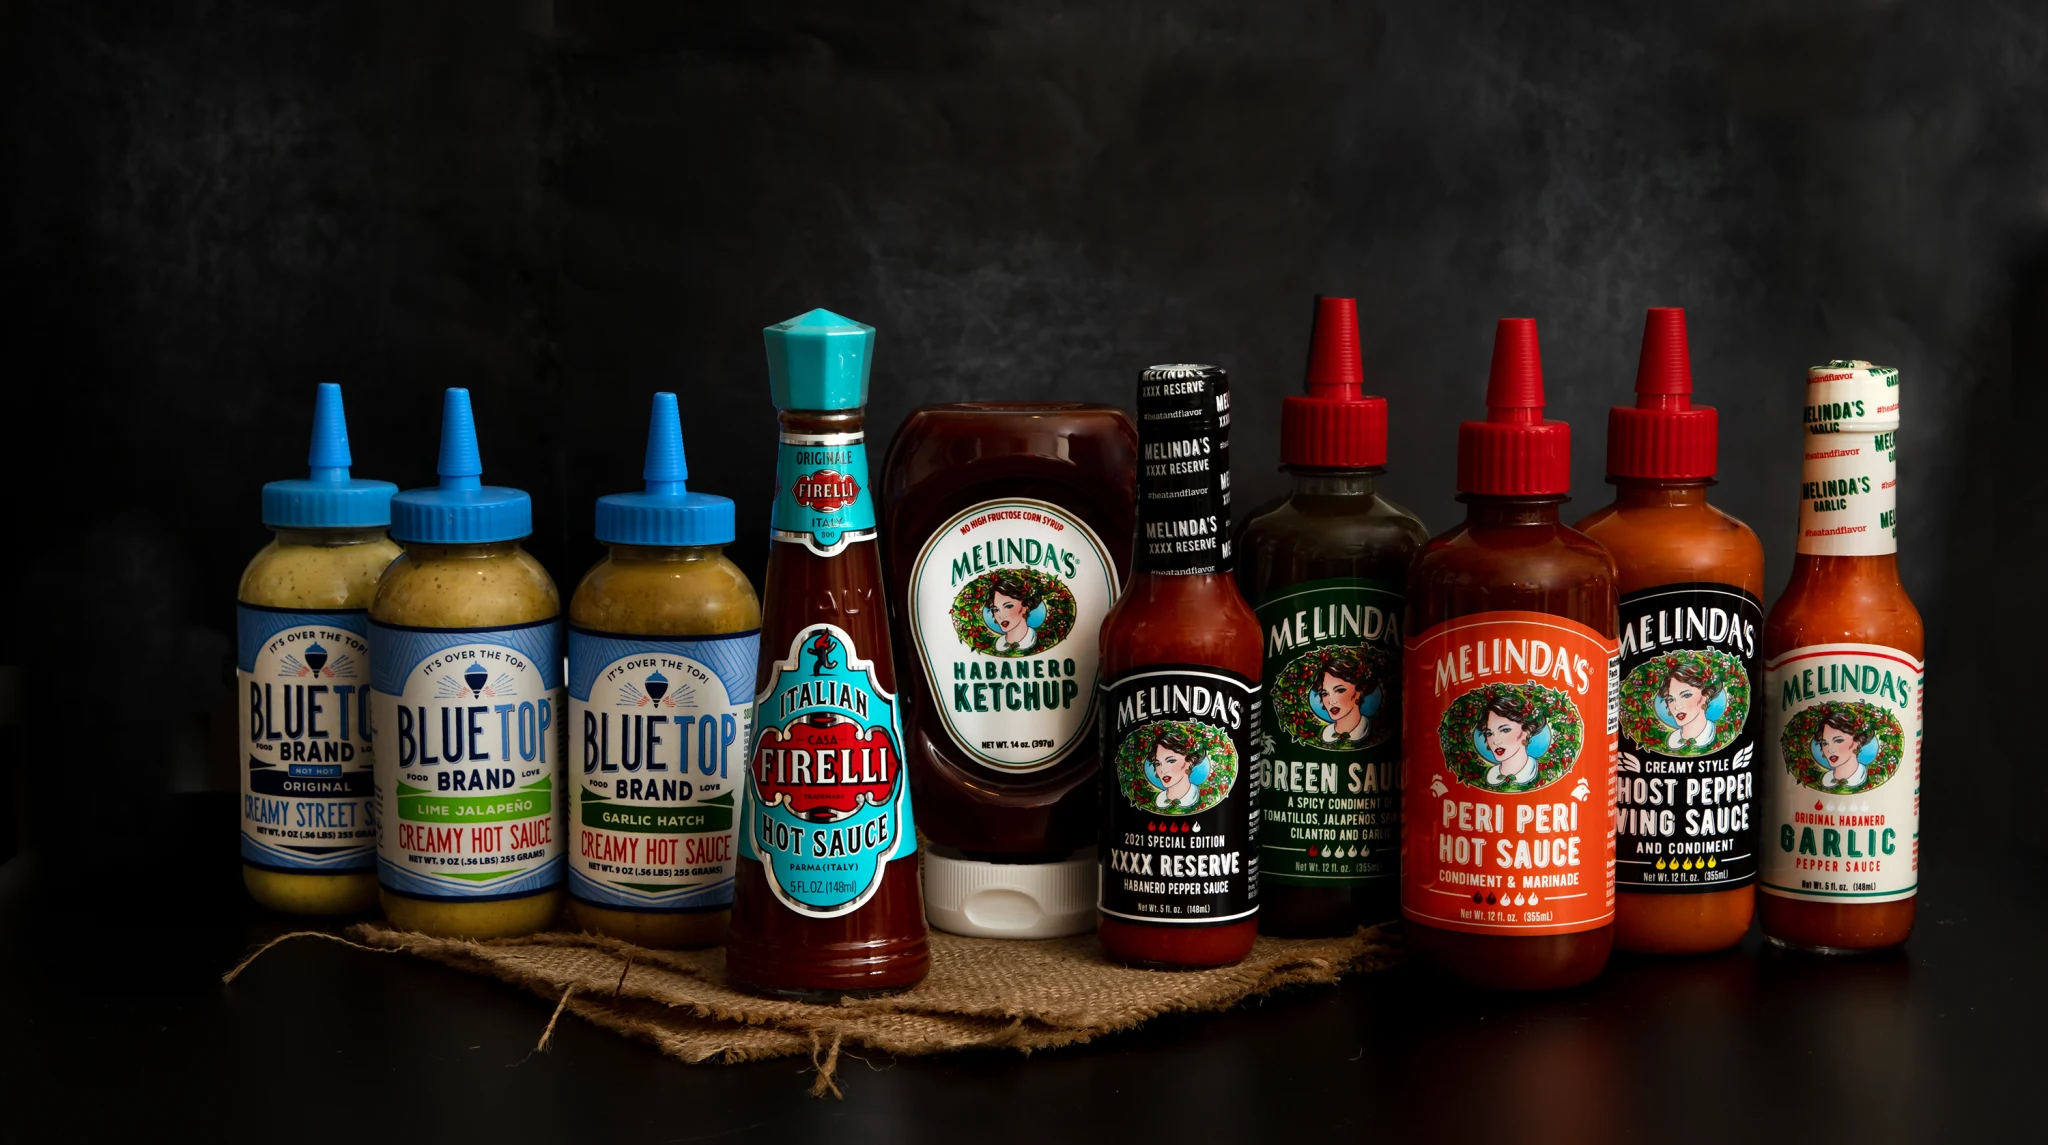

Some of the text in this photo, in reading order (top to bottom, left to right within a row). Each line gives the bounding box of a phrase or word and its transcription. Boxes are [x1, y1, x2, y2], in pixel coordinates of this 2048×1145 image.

[1143, 380, 1205, 397] XXXX RESERVE
[1810, 422, 1840, 435] GARLIC
[1145, 436, 1211, 460] MELINDA'S
[796, 451, 853, 465] ORIGINALE
[1146, 459, 1210, 476] XXXX RESERVE
[799, 483, 853, 498] FIRELLI
[1148, 488, 1208, 499] #heatandflavor
[1803, 476, 1871, 500] MELINDA'S
[1814, 498, 1847, 512] GARLIC
[812, 518, 843, 528] ITALY
[960, 511, 1064, 535] NO HIGH FRUCTOSE CORN SYRUP
[1146, 516, 1218, 539] MELINDA'S
[1805, 526, 1867, 537] #heatandflavor
[1149, 542, 1173, 555] XXXX
[1176, 537, 1217, 553] RESERVE
[951, 538, 1077, 588] MELINDA'S
[269, 631, 369, 655] IT'S OVER THE TOP!
[424, 650, 527, 676] IT'S OVER THE TOP!
[607, 659, 709, 684] IT'S OVER THE TOP!
[954, 658, 1076, 681] HABANERO
[1434, 638, 1589, 697] MELINDA'S
[954, 680, 1079, 712] KETCHUP
[1782, 664, 1909, 711] MELINDA'S
[780, 680, 869, 721] ITALIAN
[1117, 684, 1241, 732] MELINDA'S
[808, 735, 838, 745] CASA
[1010, 741, 1019, 749] 14
[1032, 740, 1054, 749] (397g)
[256, 743, 273, 751] FOOD
[280, 741, 355, 762] BRAND
[760, 747, 889, 787] FIRELLI
[1646, 759, 1729, 774] CREAMY STYLE
[407, 768, 540, 791] FOOD BRAND LOVE
[1260, 758, 1338, 794] GREEN
[283, 781, 352, 792] ORIGINAL
[590, 780, 608, 788] FOOD
[616, 779, 693, 801] BRAND
[1686, 772, 1752, 806] PEPPER
[244, 794, 290, 826] CREAMY
[296, 802, 358, 828] STREET
[418, 799, 533, 816] LIME JALAPEÑO
[1288, 796, 1380, 810] A SPICY CONDIMENT
[602, 812, 704, 826] GARLIC HATCH
[1264, 809, 1320, 826] TOMATILLOS,
[1443, 799, 1578, 833] PERI PERI
[1685, 803, 1750, 837] SAUCE
[1795, 812, 1885, 827] ORIGINAL HABANERO
[287, 830, 354, 839] OZ LBS) 255
[399, 818, 552, 854] CREAMY HOT SAUCE
[762, 812, 889, 859] HOT SAUCE
[1124, 833, 1225, 849] 2021 SPECIAL EDITION
[1290, 828, 1391, 841] CILANTRO AND GARLIC
[1780, 824, 1896, 858] GARLIC
[581, 830, 732, 865] CREAMY HOT SAUCE
[1439, 833, 1487, 867] HOT
[1496, 836, 1581, 869] SAUCE
[1636, 838, 1734, 855] AND CONDIMENT
[408, 854, 422, 863] NET
[424, 856, 439, 865] WT.
[447, 857, 459, 865] OZ
[461, 857, 478, 866] (.56
[480, 856, 499, 866] LBS)
[517, 850, 545, 861] GRAMS)
[1111, 848, 1153, 876] XXXX
[1160, 852, 1240, 878] RESERVE
[1796, 858, 1881, 872] PEPPER SAUCE
[588, 862, 601, 871] NET
[602, 864, 615, 873] WT.
[622, 866, 634, 875] OZ
[635, 867, 651, 877] (.56
[653, 868, 672, 877] LBS)
[674, 868, 690, 876] 255
[692, 866, 723, 876] GRAMS)
[1296, 862, 1330, 872] Net 12
[1439, 870, 1579, 889] CONDIMENT & MARINADE
[1643, 872, 1700, 882] Net Wt. 12 oz.
[1802, 880, 1812, 889] Net
[1124, 878, 1229, 895] HABANERO PEPPER SAUCE
[1138, 903, 1159, 913] Net Wt.
[1460, 908, 1472, 919] Net
[1474, 910, 1486, 921] Wt.
[1488, 911, 1495, 921] 12
[1508, 913, 1518, 922] oz.
